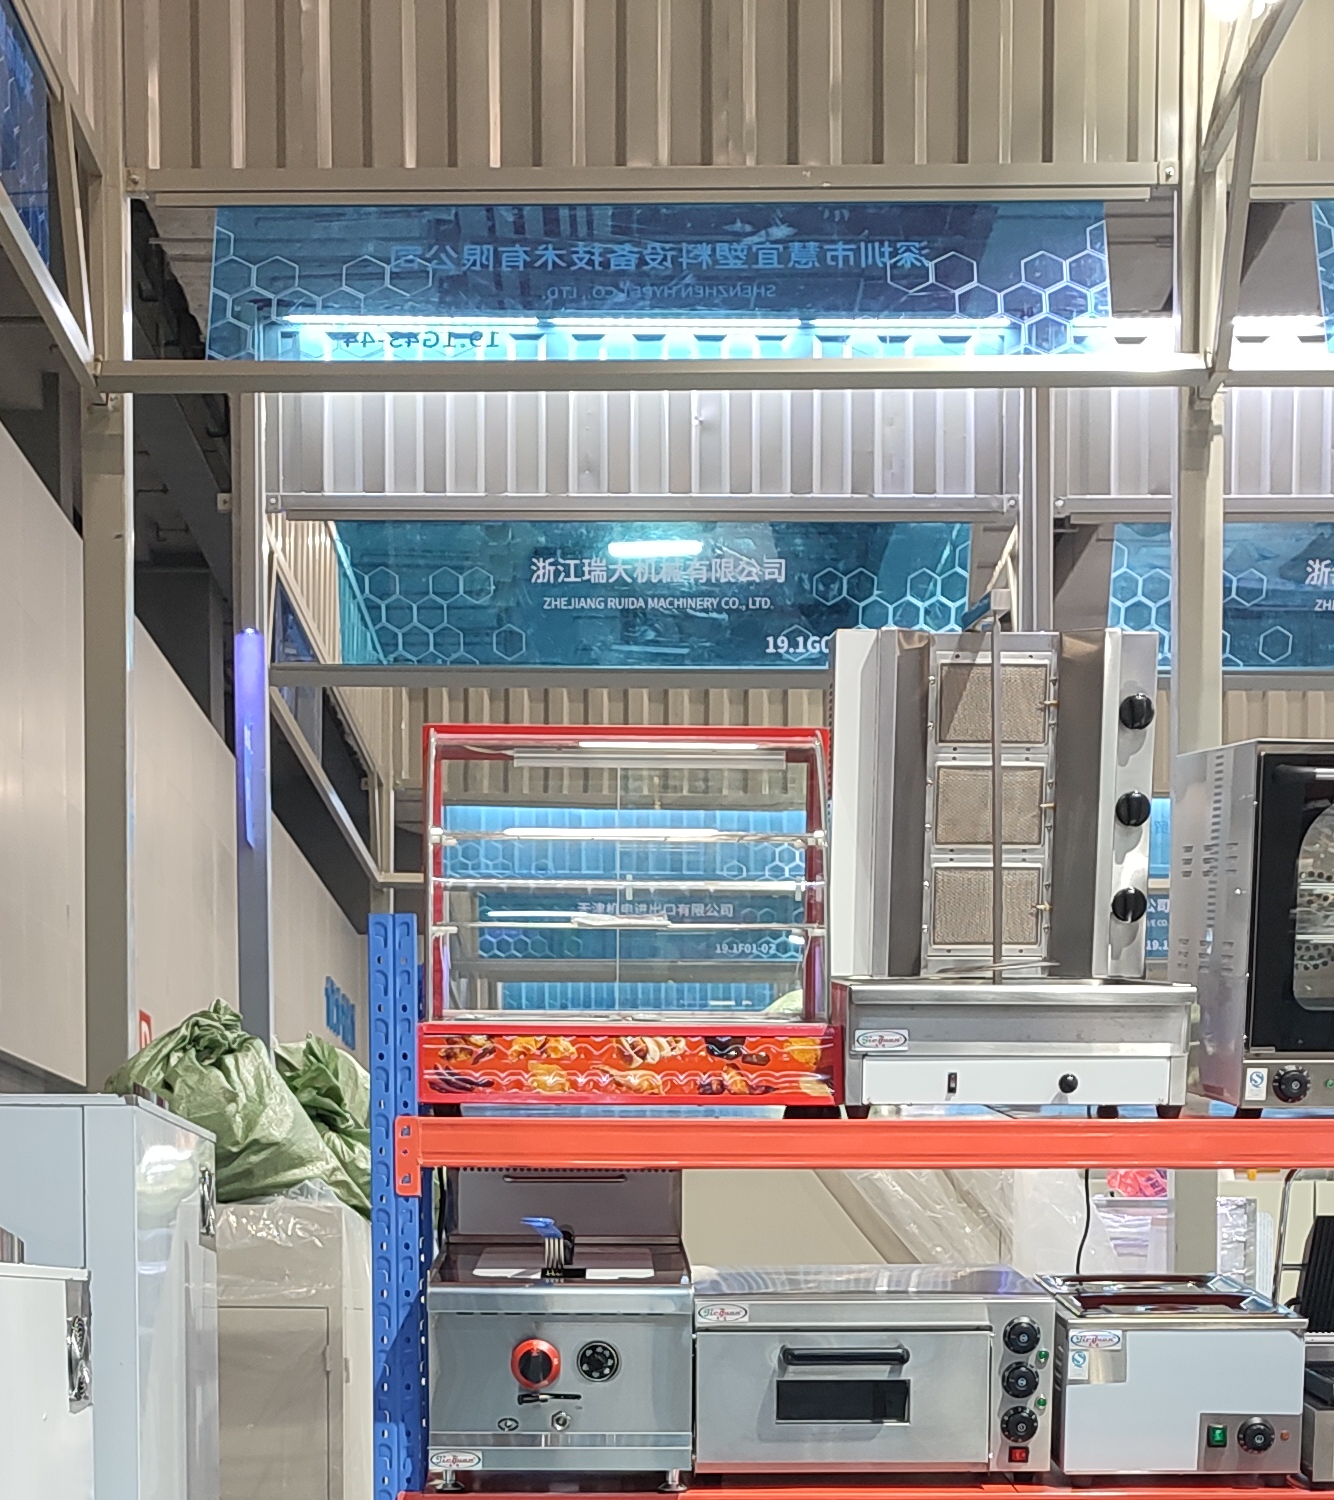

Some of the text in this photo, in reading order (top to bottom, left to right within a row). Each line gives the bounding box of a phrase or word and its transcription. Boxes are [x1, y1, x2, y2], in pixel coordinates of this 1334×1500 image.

[530, 557, 786, 584] 浙江瑞大机械有限公司
[543, 597, 774, 611] ZHEJIANG RUIDA MACHINERY CO., LTD.
